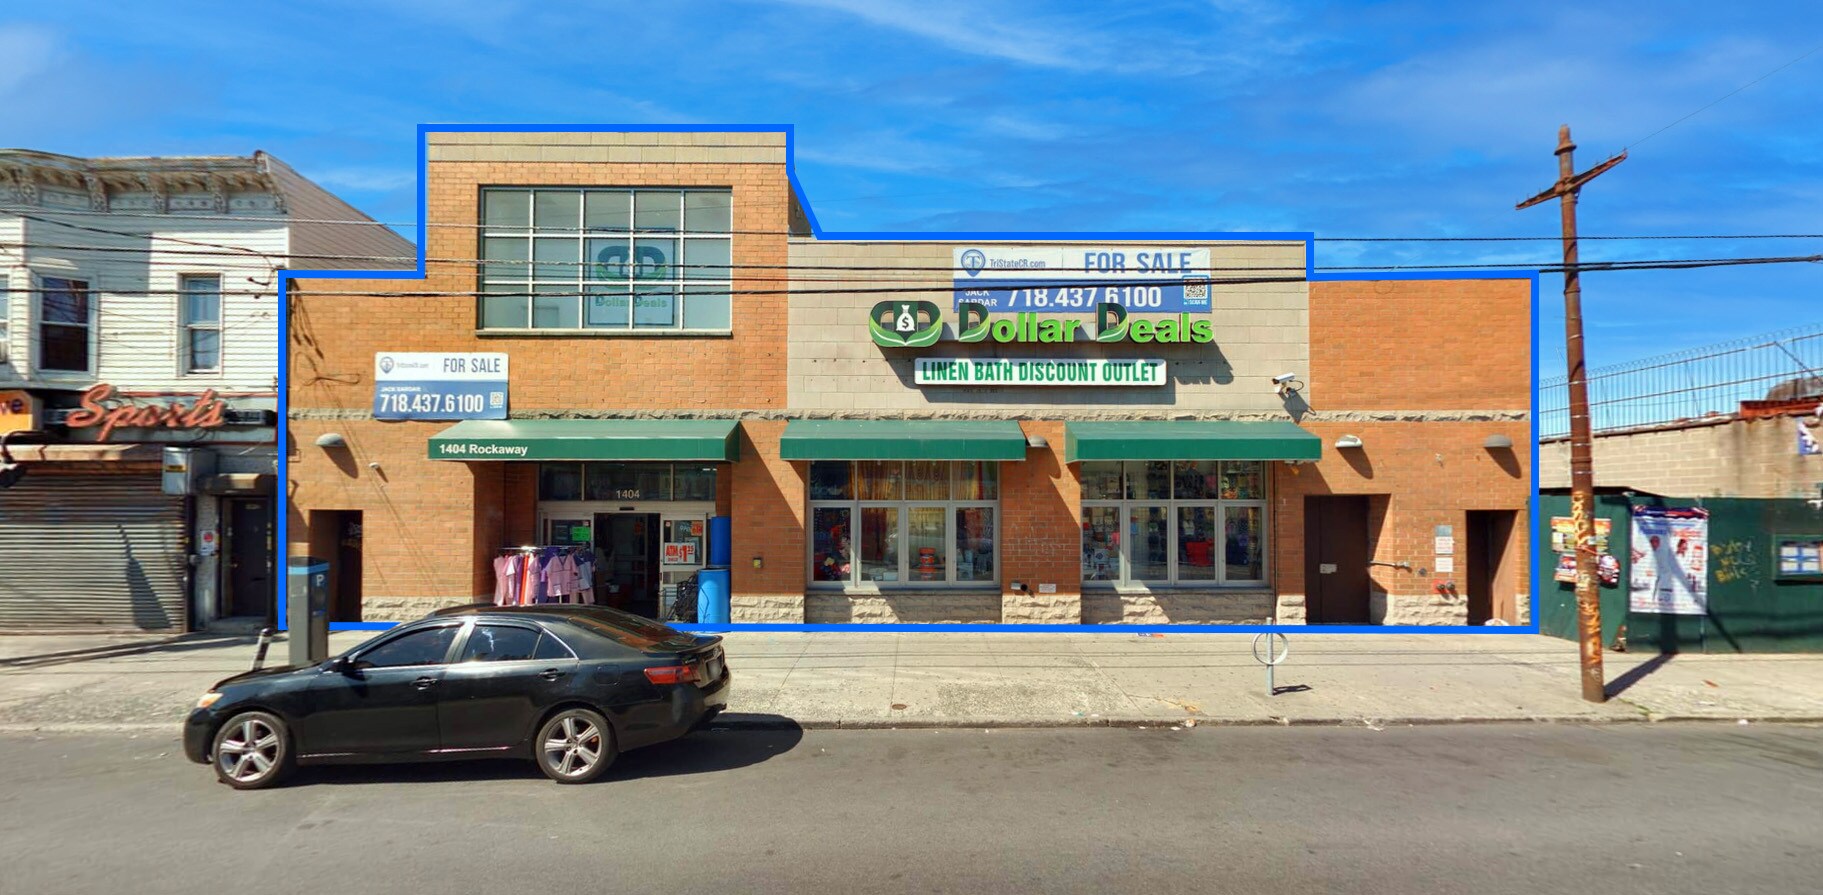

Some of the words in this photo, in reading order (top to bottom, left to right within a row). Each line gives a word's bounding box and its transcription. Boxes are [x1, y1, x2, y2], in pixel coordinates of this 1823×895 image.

[989, 258, 1046, 268] TriStateCR.com
[1084, 252, 1125, 274] FOR
[1137, 252, 1192, 274] SALE
[595, 296, 629, 307] Dolla
[635, 296, 667, 307] Deals
[1007, 287, 1162, 307] 718.4376100
[958, 302, 1081, 343] Dollar
[1096, 302, 1214, 343] Deals
[443, 358, 466, 373] FOR
[471, 358, 501, 373] SALE
[922, 361, 969, 381] LINEN
[975, 362, 1013, 381] BATH
[1019, 362, 1097, 382] DISCOUNT
[1103, 362, 1158, 382] OUTLET
[380, 394, 484, 413] 718.437.6100
[66, 383, 226, 442] Sports
[439, 444, 467, 454] 1404
[469, 444, 528, 456] Rockaway
[616, 489, 640, 499] 1404
[316, 574, 325, 587] P
